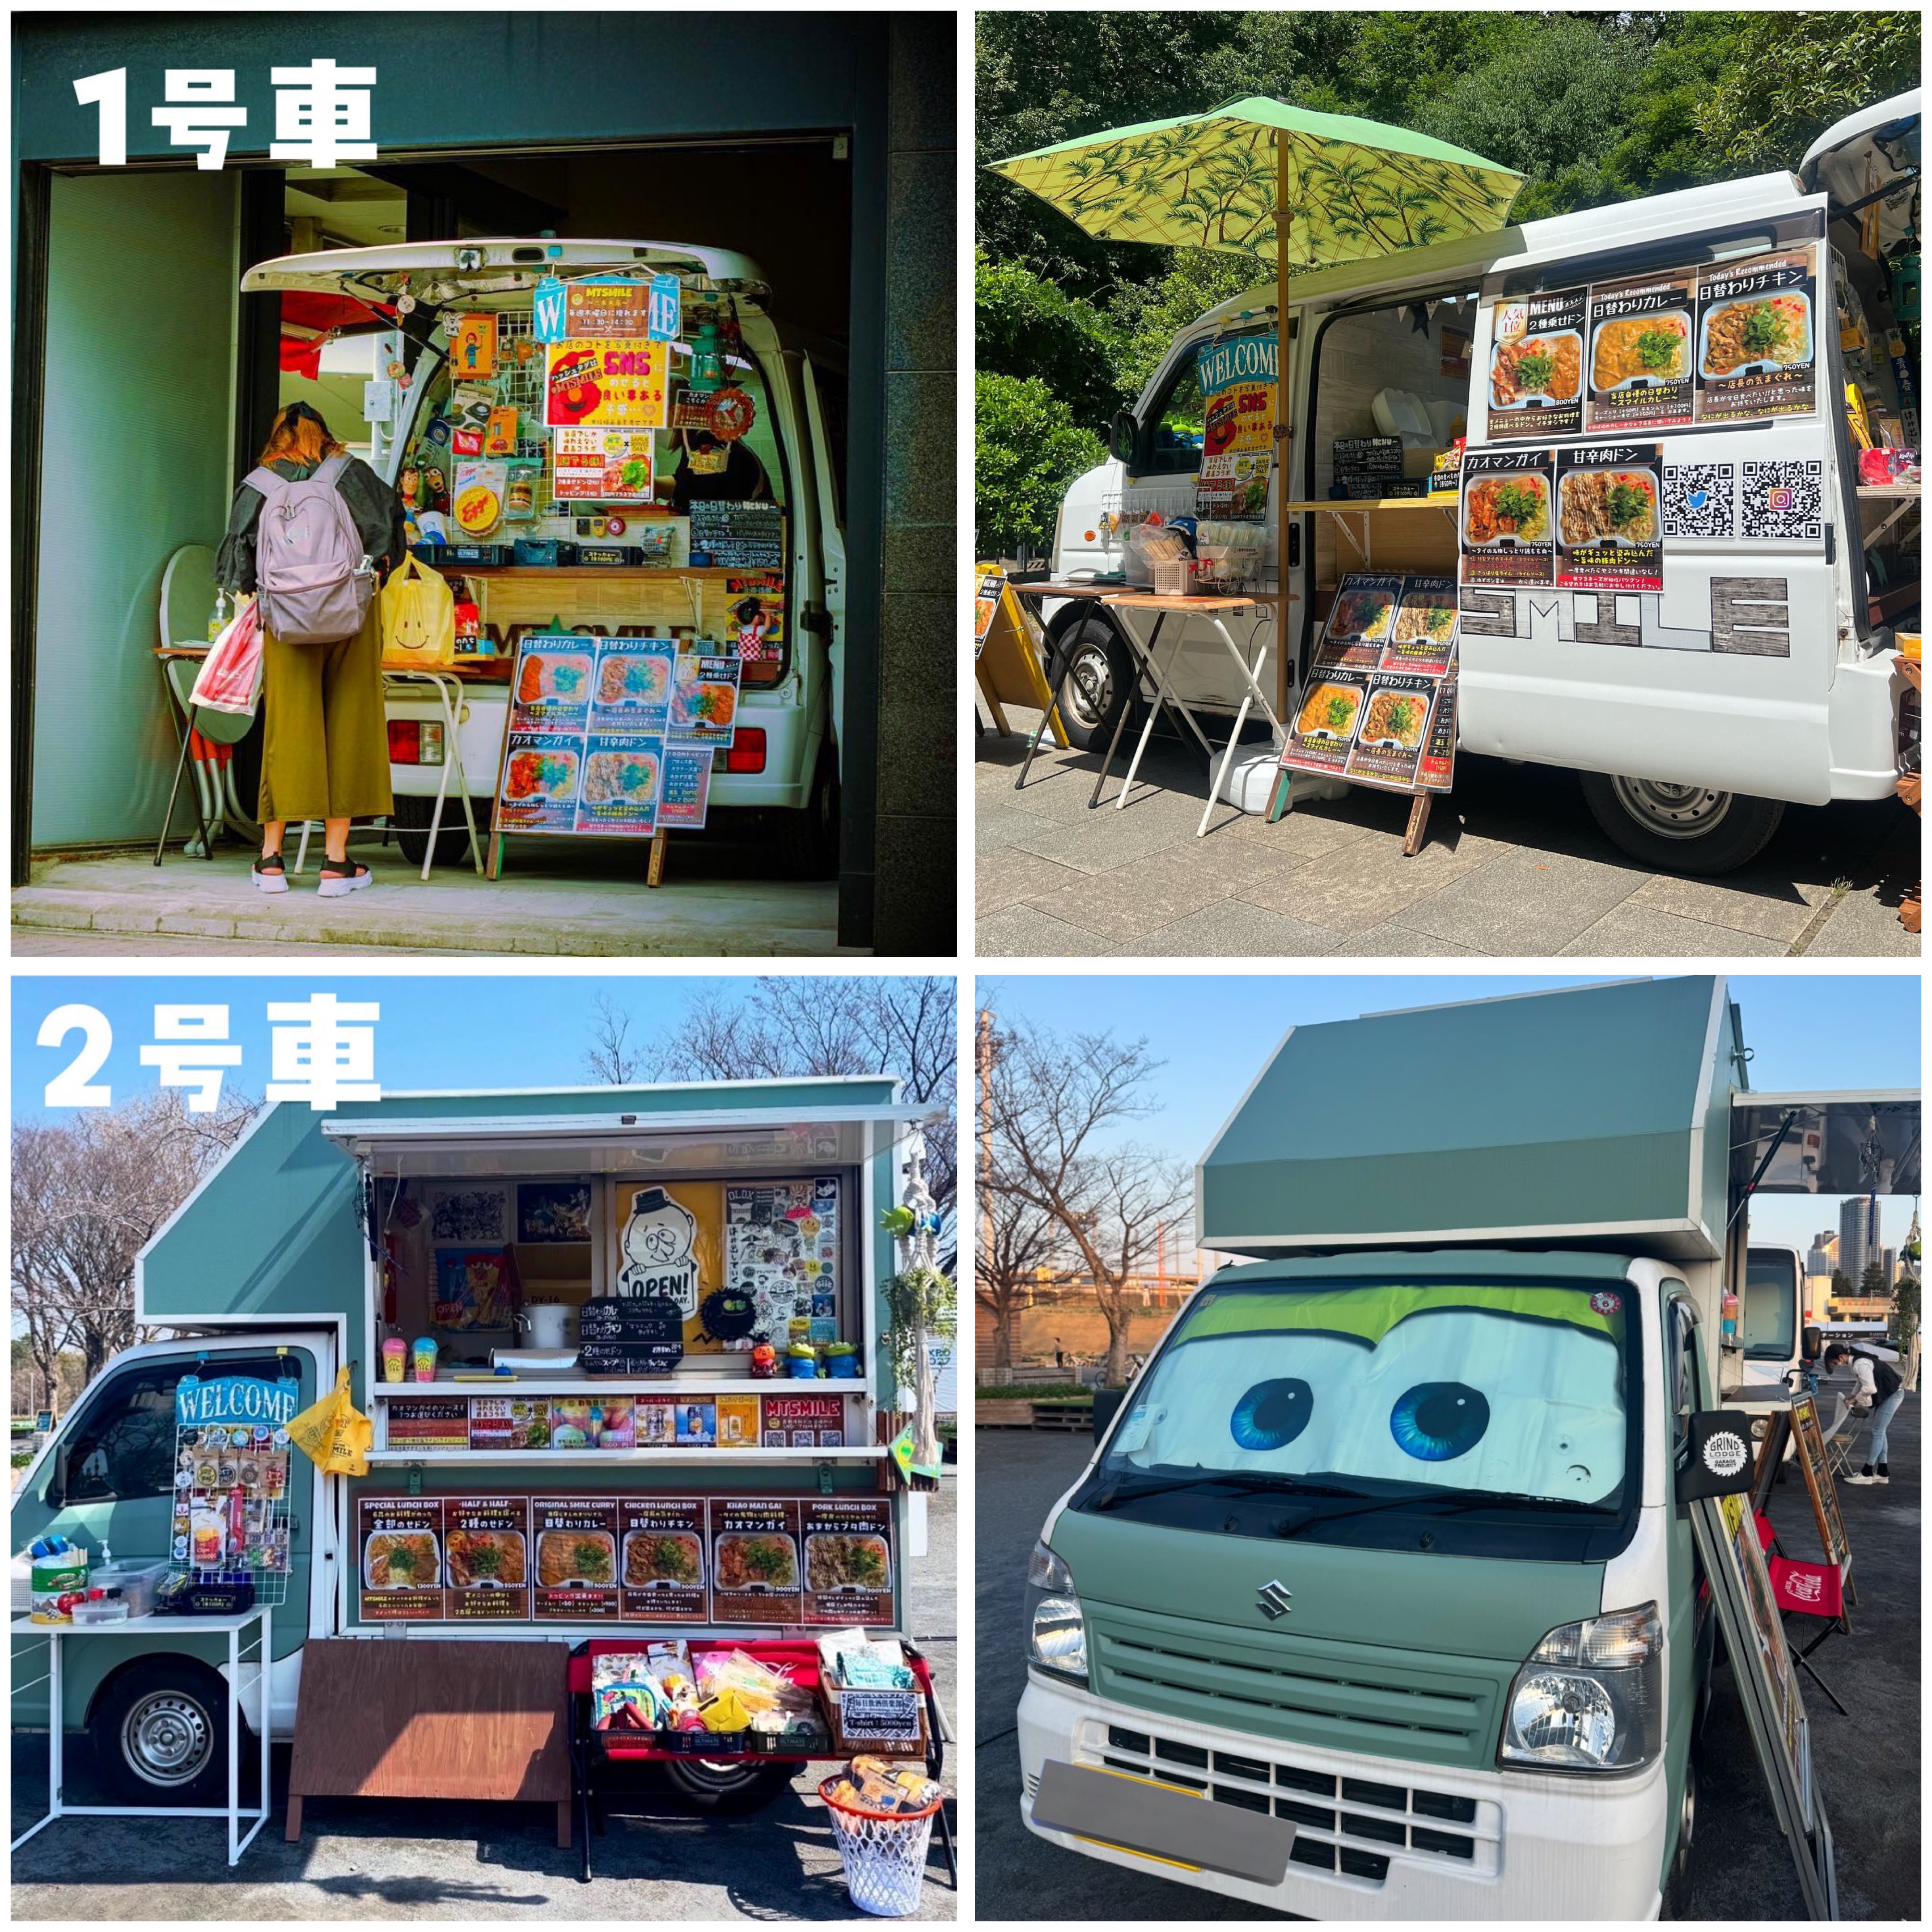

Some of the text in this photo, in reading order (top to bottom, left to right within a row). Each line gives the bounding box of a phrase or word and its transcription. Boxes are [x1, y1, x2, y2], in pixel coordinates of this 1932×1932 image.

[1709, 259, 1787, 282] Today's Recommended
[1601, 283, 1670, 301] Today's Recommended
[1700, 271, 1803, 301] 日替わりチキン
[586, 288, 632, 297] MTSMILE
[1530, 298, 1564, 315] MENU
[1593, 295, 1682, 318] 日替わりカレー
[1502, 308, 1525, 321] 人気
[1503, 321, 1521, 333] 1位
[1529, 314, 1585, 330] 2種乗せドン
[604, 351, 650, 375] SNS
[1783, 363, 1810, 371] 750YEN
[1665, 377, 1689, 386] 750YEN
[1718, 373, 1803, 389] ～店長の気まぐれ～
[1611, 386, 1678, 400] 当店自慢の日替わり
[1238, 391, 1268, 414] SNS
[1555, 398, 1579, 406] 800YEN
[1611, 395, 1678, 406] ～スマイルカレー～
[1467, 452, 1542, 470] カオマンガイ
[1572, 448, 1638, 464] 甘辛肉ドン
[1572, 549, 1653, 557] 味がギュッと染み込んだ
[1344, 576, 1394, 587] カオマンガイ
[1415, 579, 1454, 589] 甘辛肉ドン
[1460, 576, 1790, 658] SMILE
[525, 640, 589, 648] 日替わりカレー
[600, 640, 669, 651] 日替わりチキン
[701, 660, 724, 669] MENU
[1310, 669, 1364, 682] 日替わりカレー
[1372, 674, 1431, 689] 日替わりチキン
[512, 735, 576, 746] カオマンガイ
[600, 736, 647, 747] 甘辛肉ドン
[631, 1272, 689, 1297] OPEN!
[179, 1384, 295, 1424] WELCOME
[766, 1400, 840, 1416] MTSMILE
[1711, 1437, 1740, 1451] GRIND
[364, 1501, 396, 1509] SPECIAL
[373, 1519, 430, 1529] 全部のせドン
[460, 1518, 513, 1529] 2種のせドン
[545, 1518, 606, 1528] 日替わりカレー
[630, 1518, 694, 1528] 日替わりチキン
[724, 1520, 785, 1530] カオマンガイ
[806, 1521, 886, 1531] あまからブタ肉ドン
